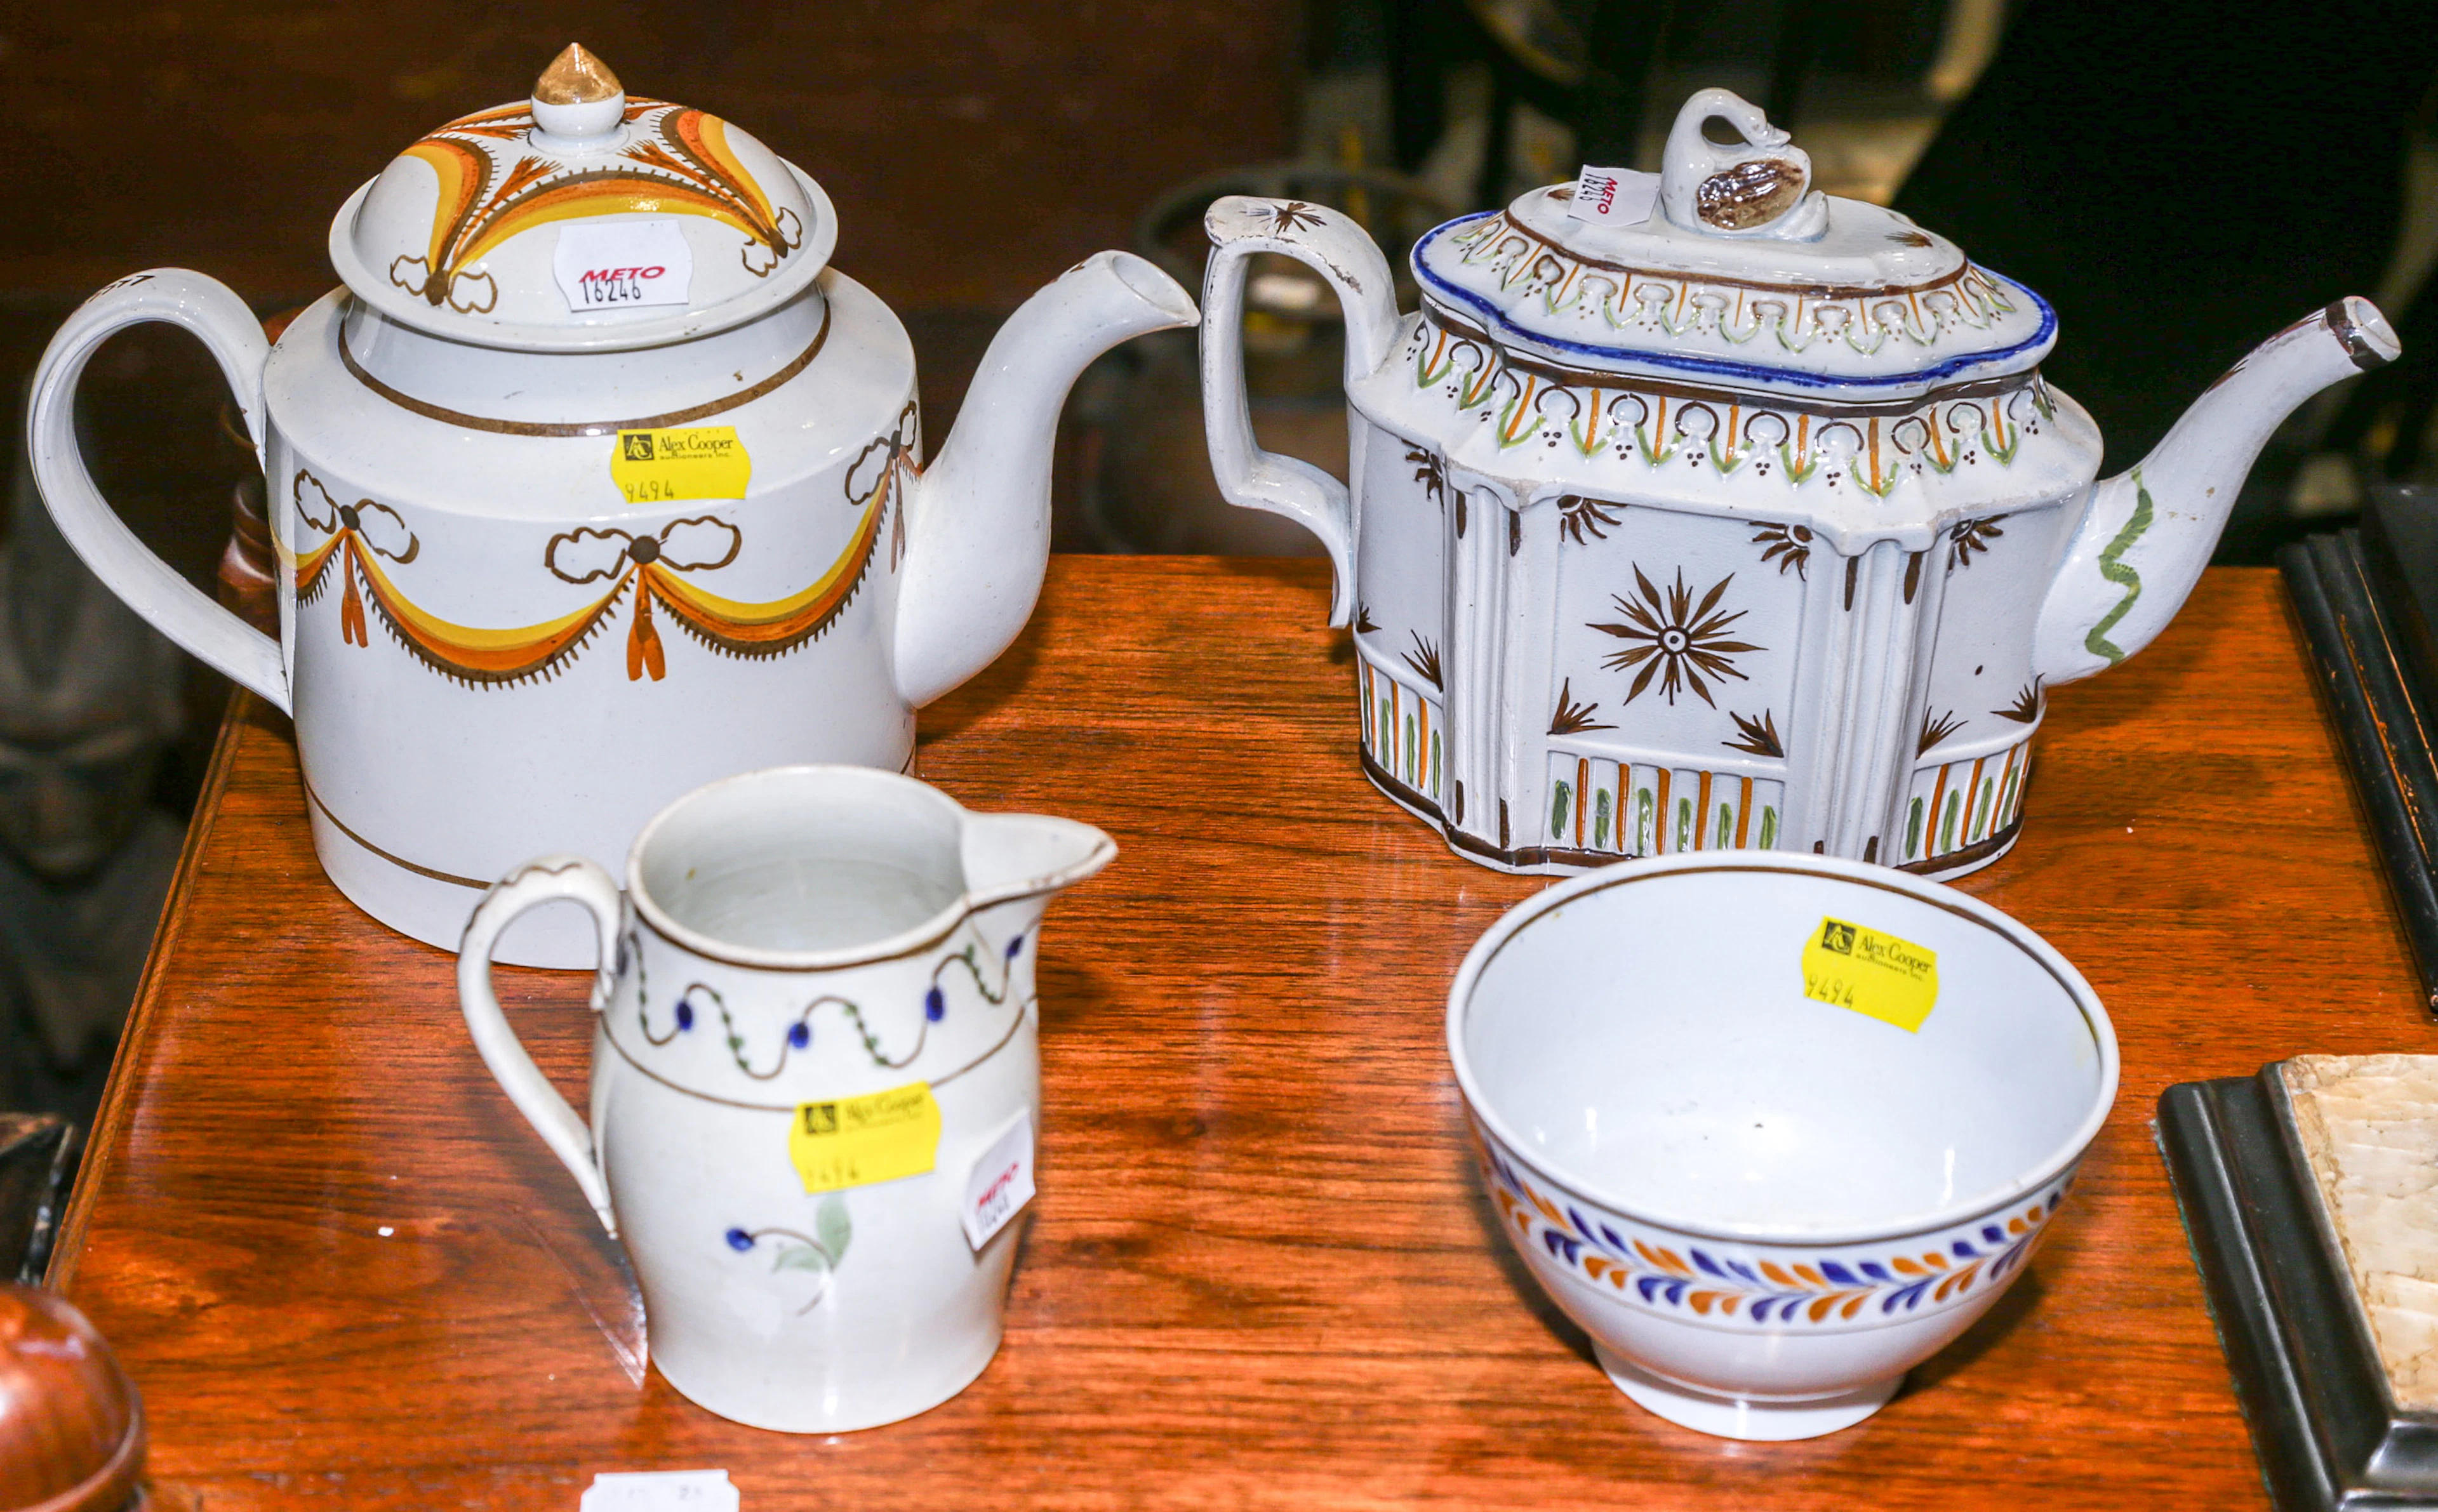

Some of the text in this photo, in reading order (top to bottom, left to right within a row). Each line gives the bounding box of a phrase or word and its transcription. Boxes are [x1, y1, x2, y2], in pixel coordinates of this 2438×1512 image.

[1597, 176, 1618, 215] METO
[578, 265, 666, 283] METO
[582, 277, 642, 305] 16246
[658, 434, 734, 454] Alex Cooper
[625, 479, 674, 502] 9494
[1858, 935, 1933, 974] Alex Cooper
[1808, 974, 1855, 1008] 9494
